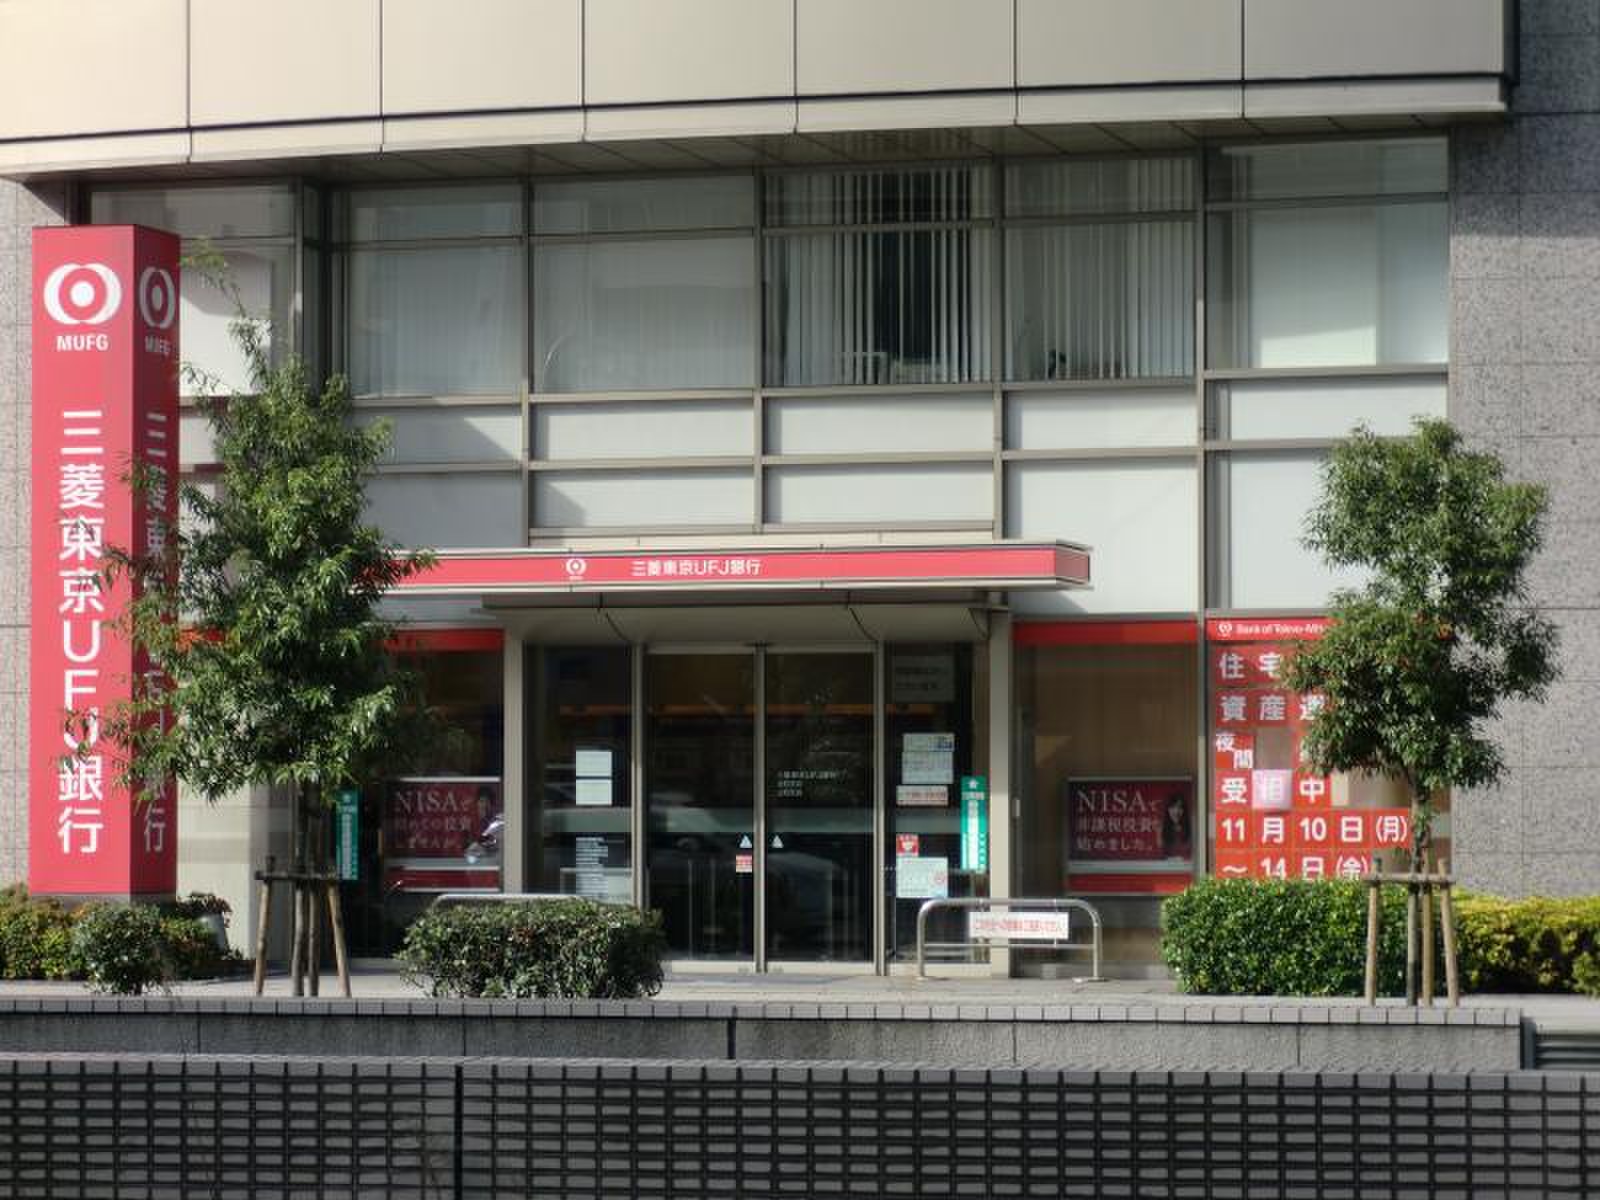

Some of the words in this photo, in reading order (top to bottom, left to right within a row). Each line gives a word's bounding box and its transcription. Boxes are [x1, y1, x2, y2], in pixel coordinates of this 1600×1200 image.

[57, 334, 109, 350] MUFG
[631, 559, 761, 576] 三菱東京UFJ銀行
[58, 410, 105, 854] 三菱東京UFJ銀行
